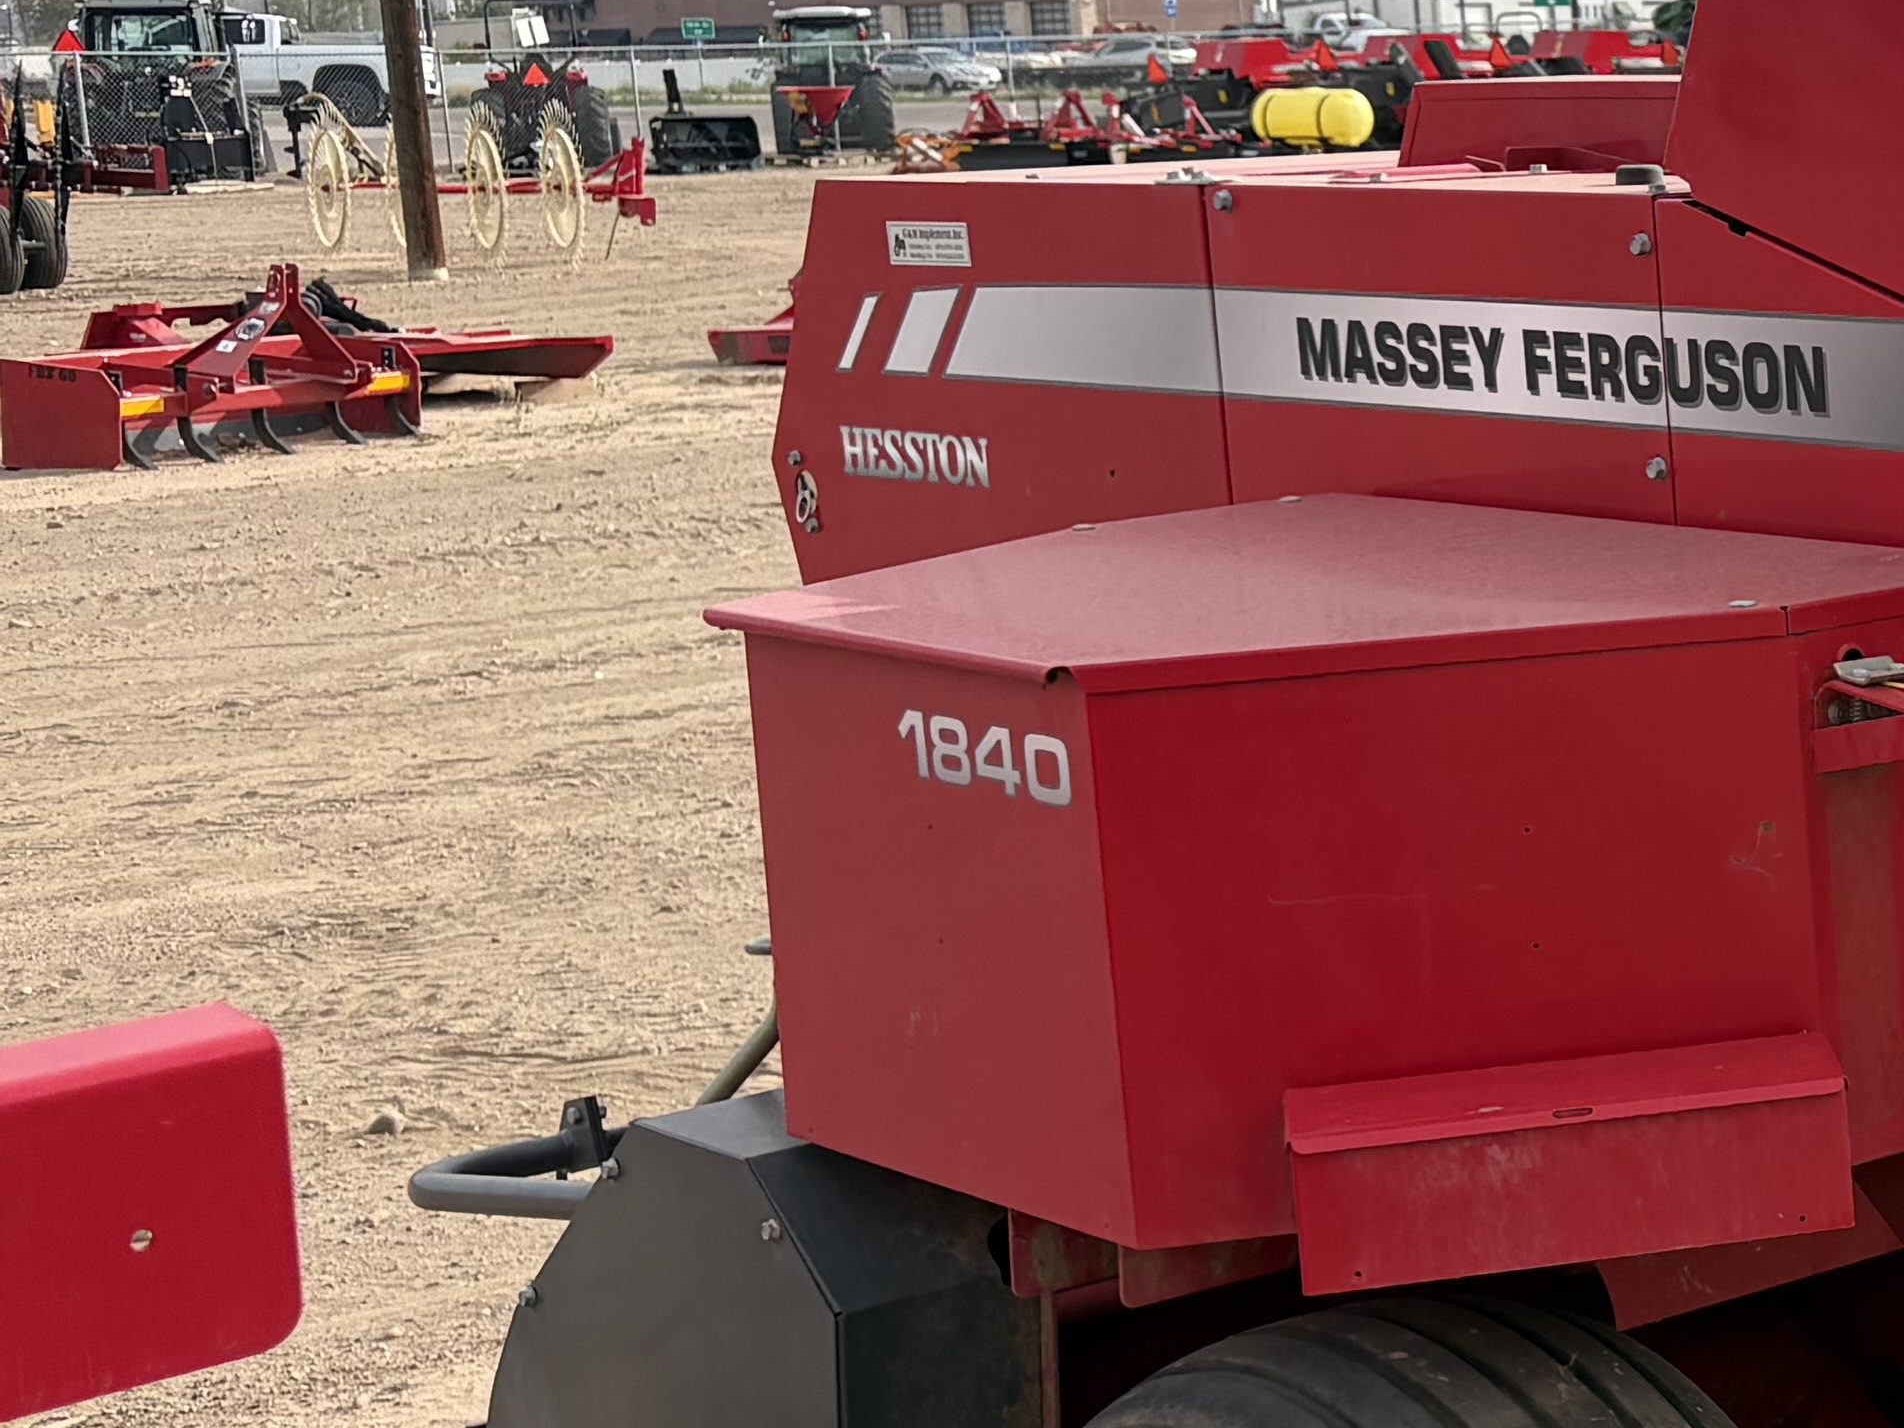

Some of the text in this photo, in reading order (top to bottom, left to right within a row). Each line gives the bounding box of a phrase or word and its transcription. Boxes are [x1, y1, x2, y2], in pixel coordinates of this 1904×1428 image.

[1296, 317, 1830, 418] MASSEY FERGUSON
[839, 425, 989, 488] HESSTON
[898, 709, 1072, 807] 1840
